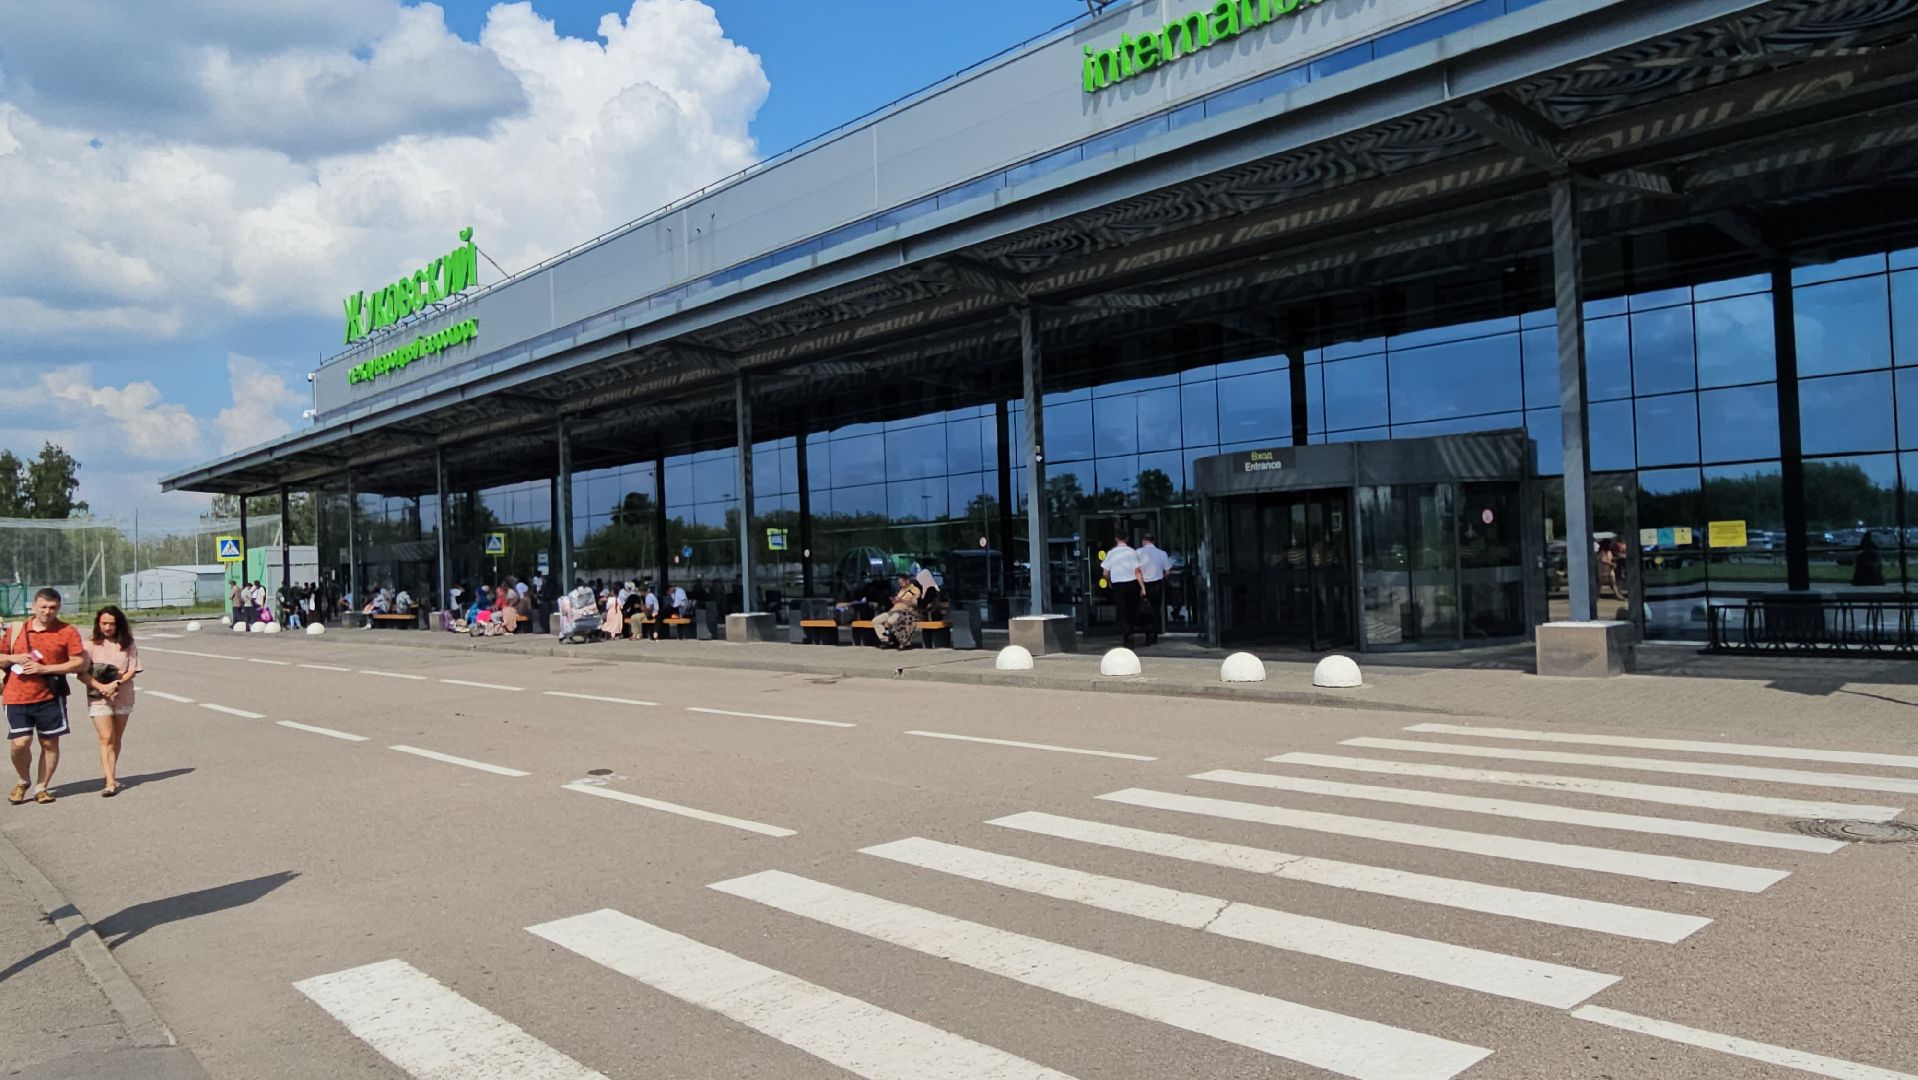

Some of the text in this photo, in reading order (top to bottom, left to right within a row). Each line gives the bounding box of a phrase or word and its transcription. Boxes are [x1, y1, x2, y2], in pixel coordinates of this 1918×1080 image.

[344, 227, 477, 345] Жуковский
[1251, 451, 1273, 461] Вход
[1244, 461, 1282, 472] Entrance
